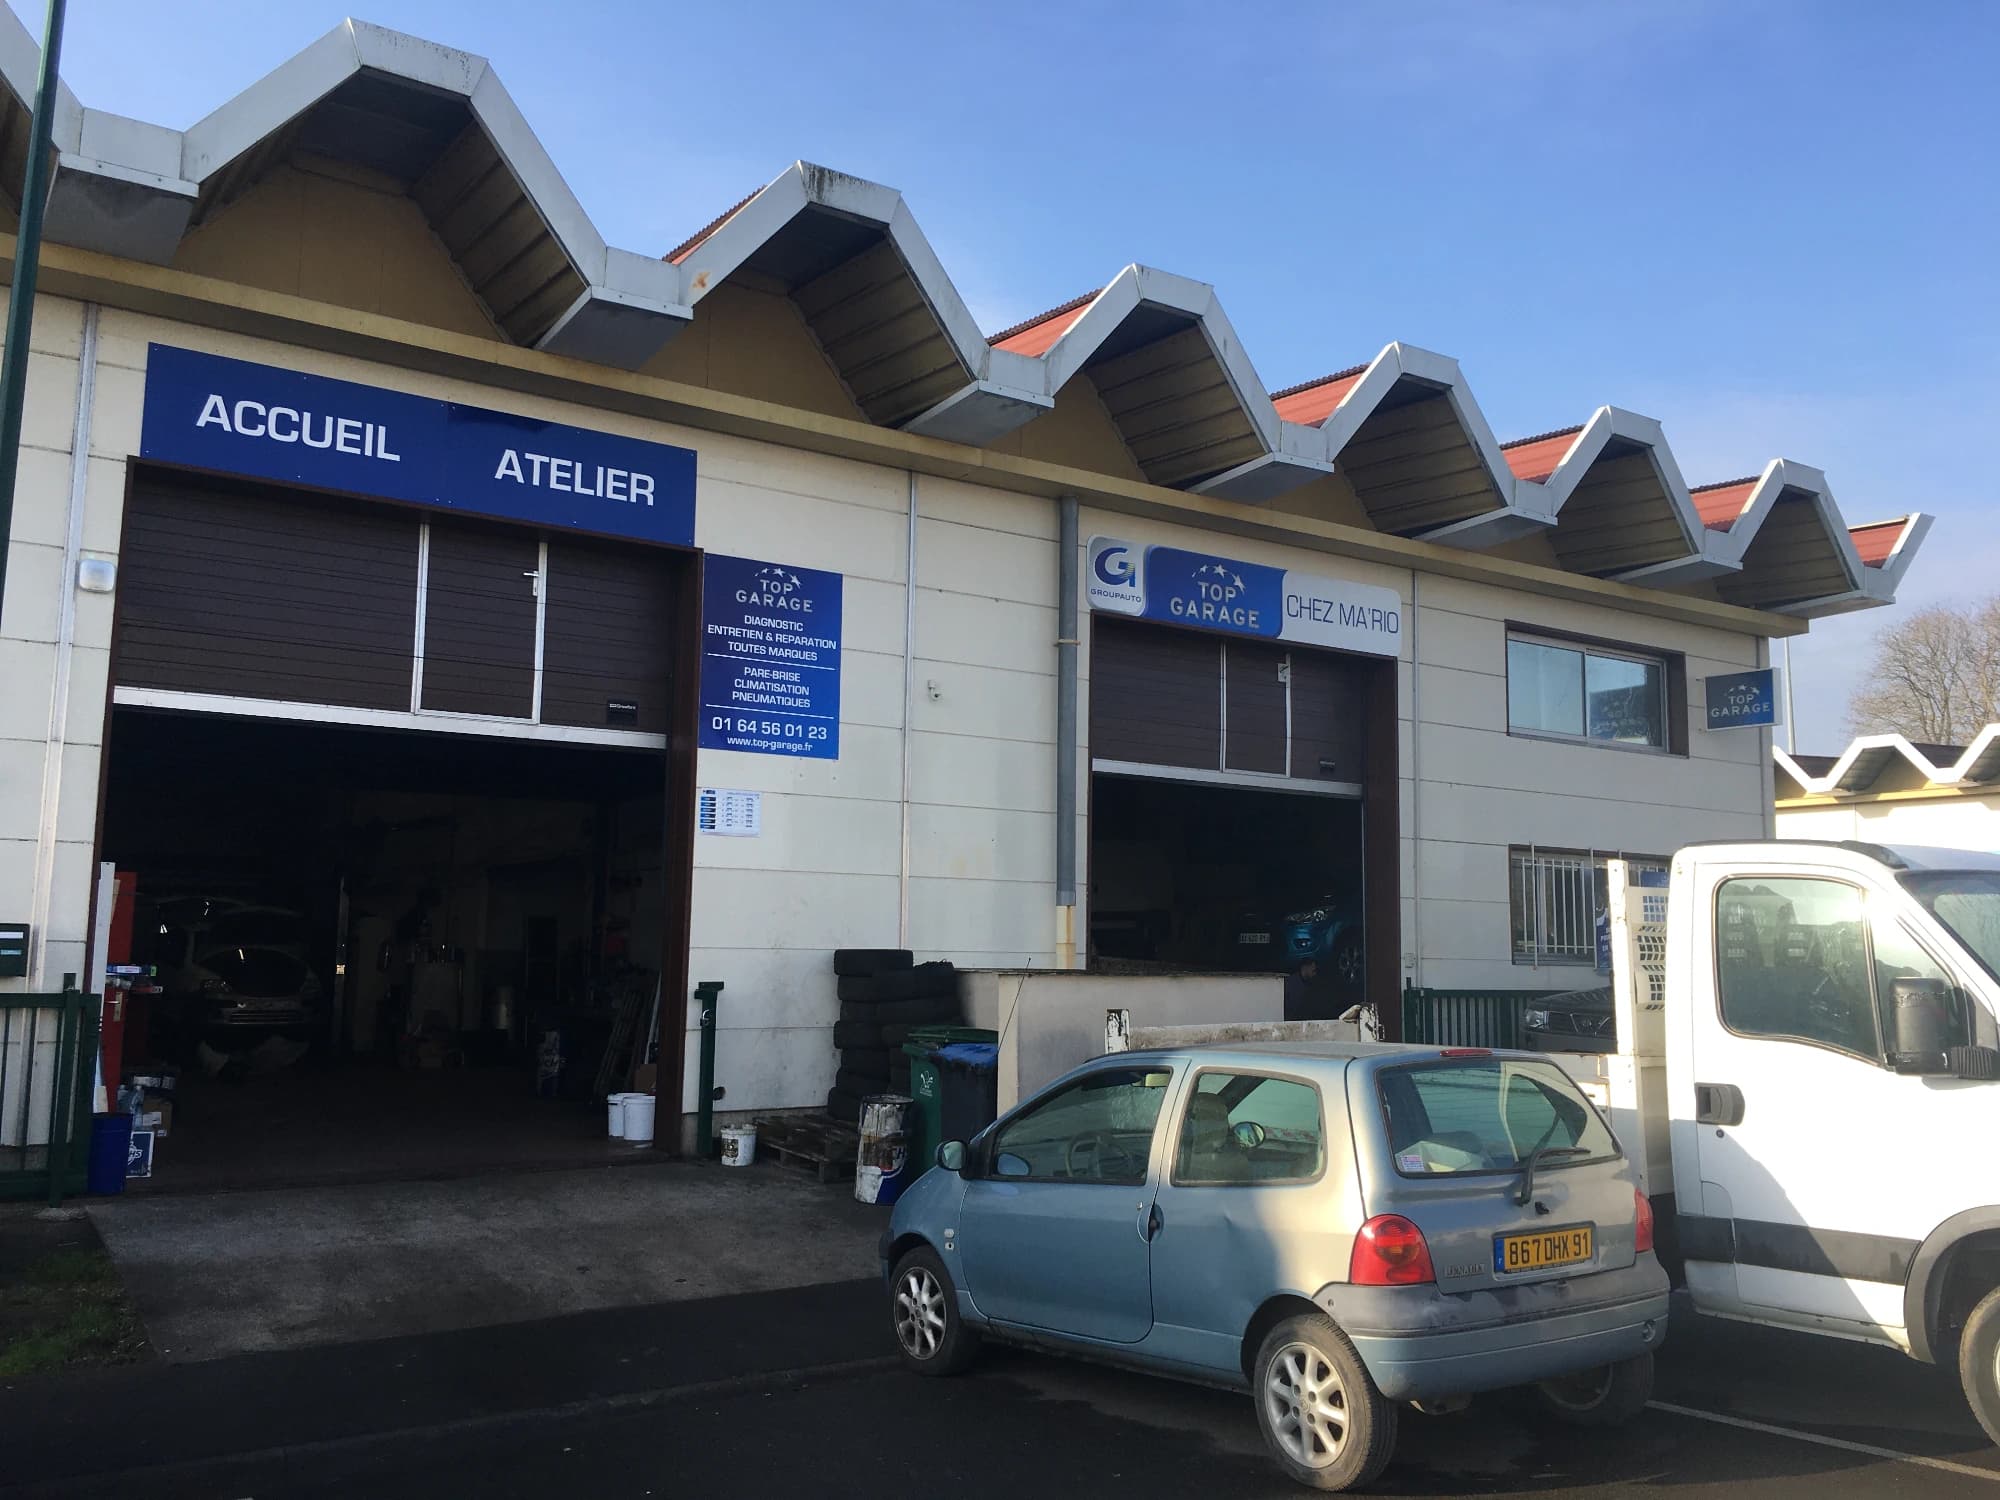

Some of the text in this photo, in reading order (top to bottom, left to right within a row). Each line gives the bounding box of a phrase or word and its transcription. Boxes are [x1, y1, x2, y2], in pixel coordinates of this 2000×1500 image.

[196, 394, 655, 506] ACCUEIL ATELIER
[760, 579, 794, 595] TOP
[1090, 588, 1142, 603] GROUPAUTO
[1198, 581, 1237, 603] TOP
[736, 589, 813, 613] GARAGE
[1170, 597, 1260, 629] GARAGE
[1286, 595, 1399, 634] CHEZ MA'RIO
[744, 615, 804, 632] DIAGNOSTIC
[707, 624, 837, 650] ENTRETIEN & REPARATION
[728, 641, 818, 662] TOUTES MARQUES
[744, 667, 801, 682] PARE-BRISE
[734, 679, 810, 696] CLIMATISATION
[732, 691, 811, 709] PNEUMATIQUES
[1728, 694, 1754, 705] TOP
[1711, 702, 1770, 718] GARAGE
[712, 717, 827, 740] 01 64 56 01 23
[727, 736, 813, 752] www.top-garage.fr
[1509, 1232, 1588, 1265] 867 DHX 91
